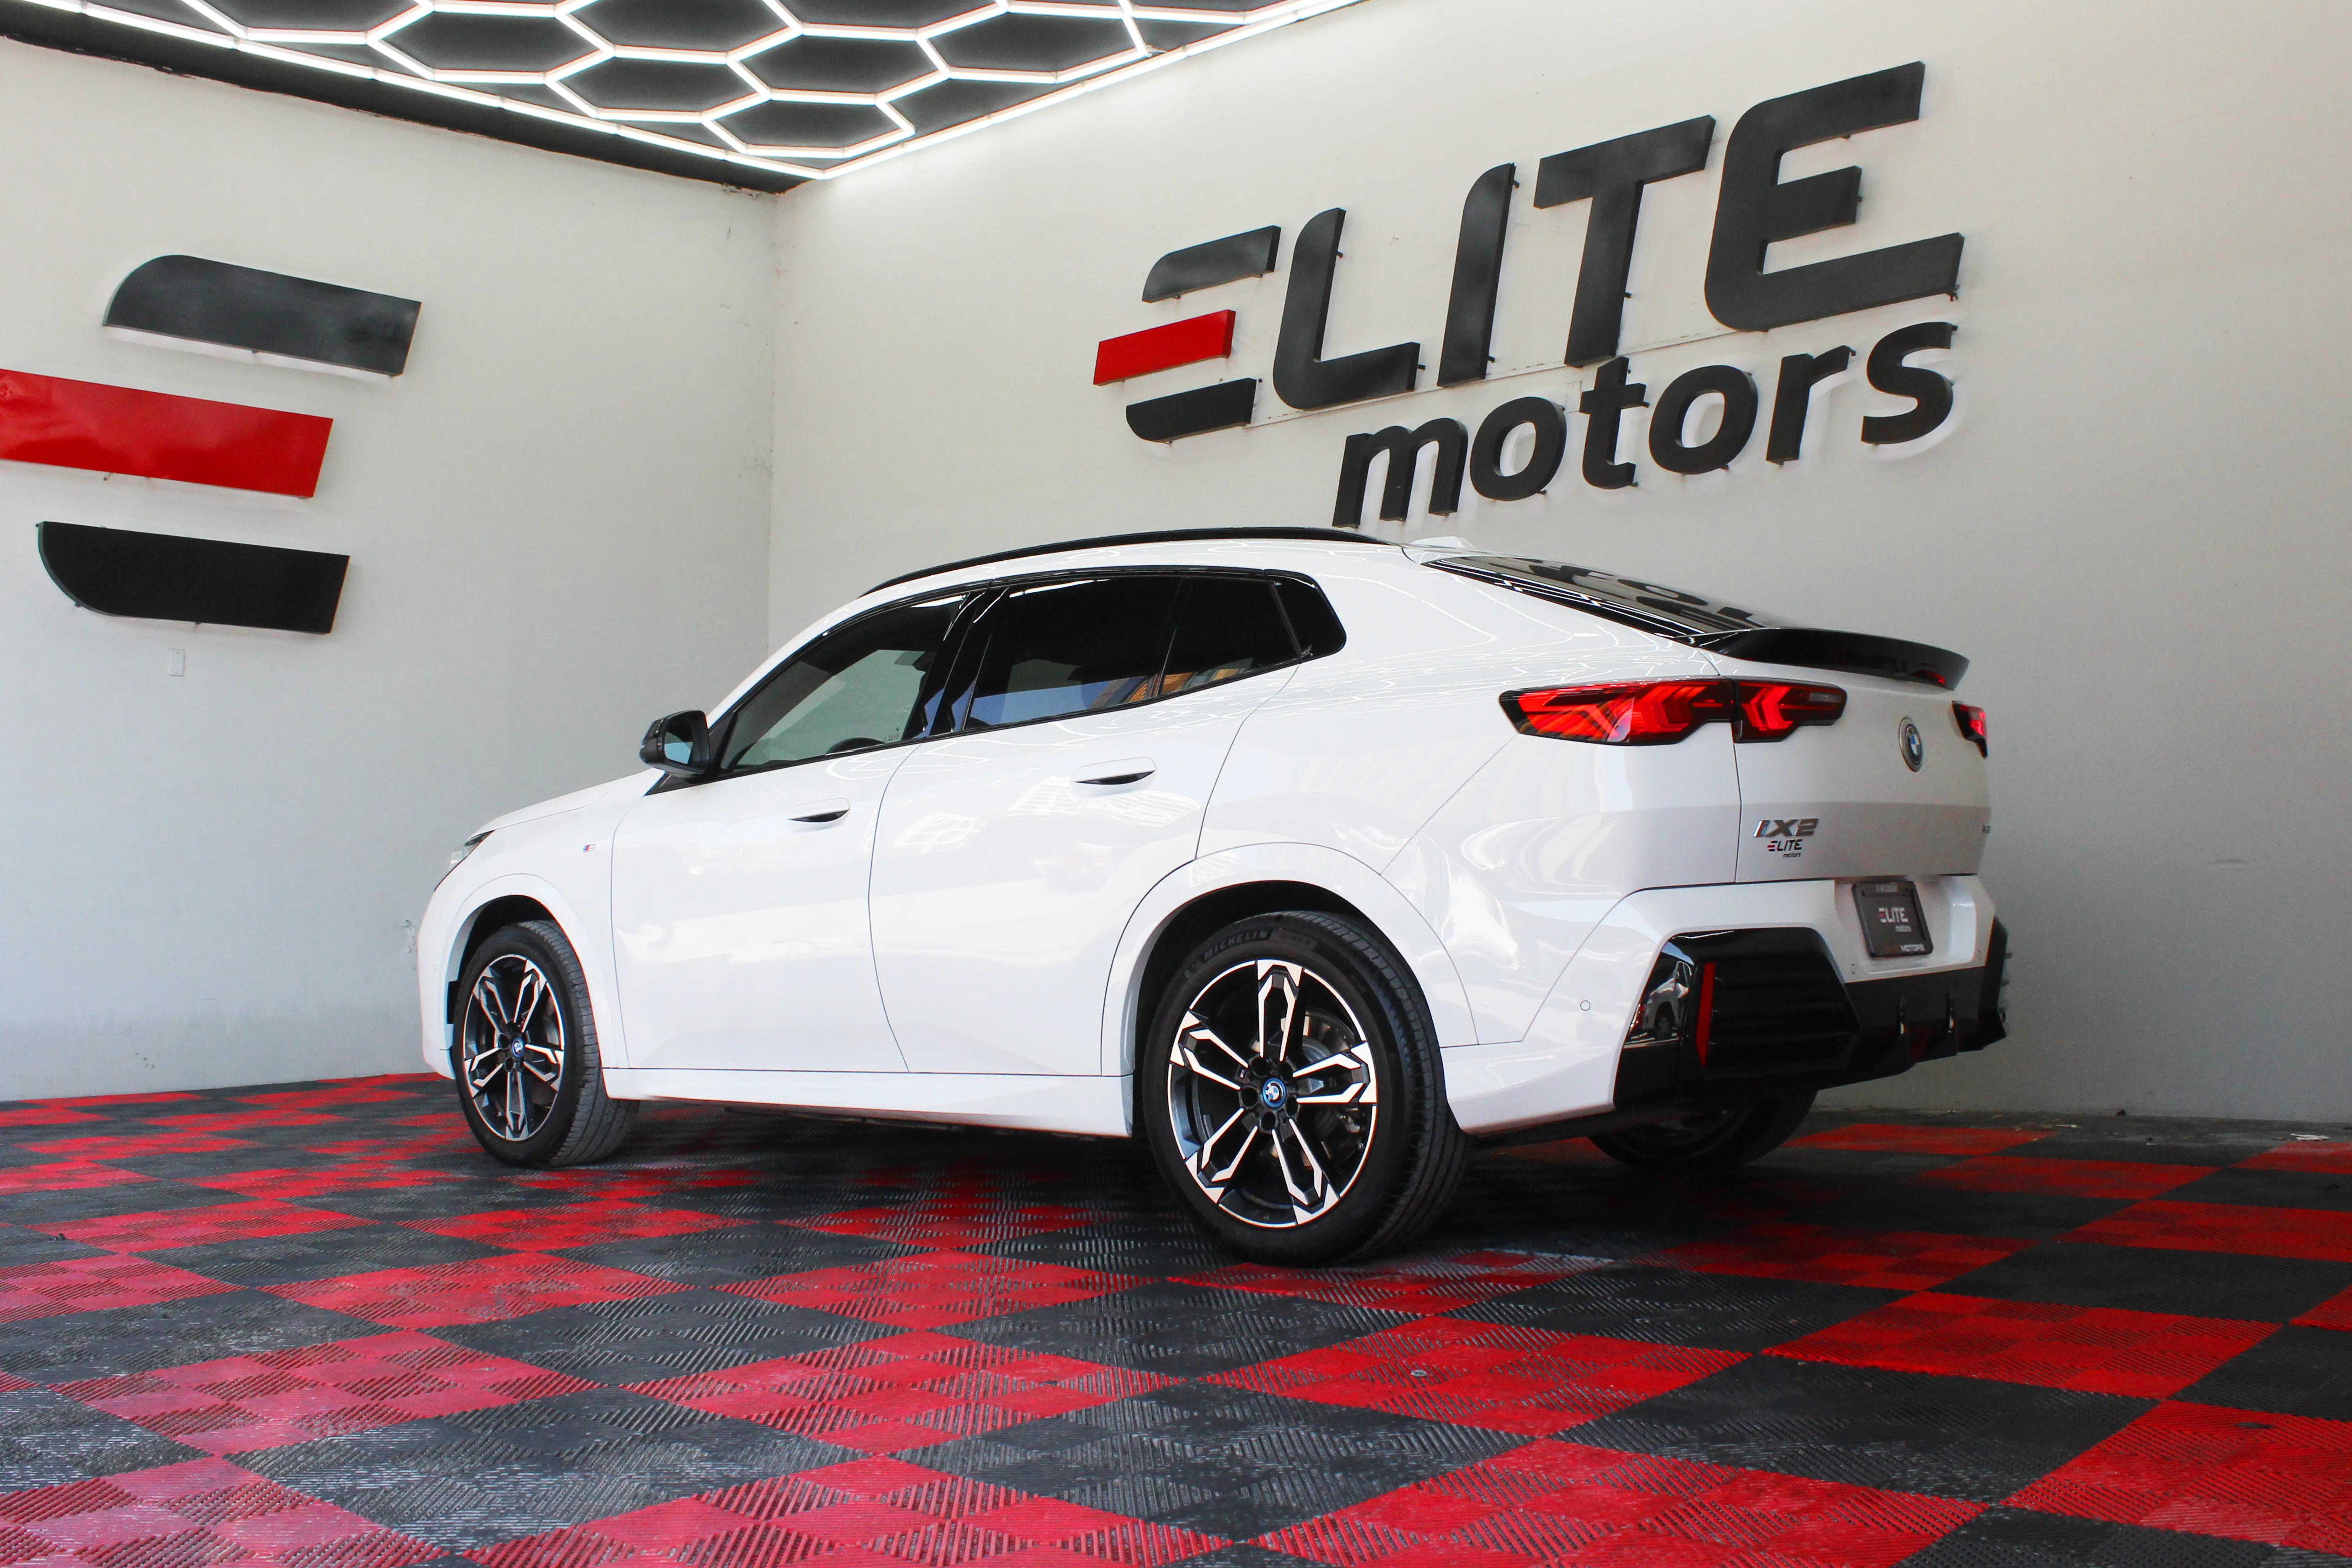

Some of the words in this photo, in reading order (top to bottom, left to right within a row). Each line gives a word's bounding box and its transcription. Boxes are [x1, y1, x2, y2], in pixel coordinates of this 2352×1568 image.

[1094, 61, 1964, 440] ELITE
[1333, 322, 1958, 527] motors
[1767, 839, 1803, 852] ELITE
[1878, 907, 1909, 923] ELITE
[1204, 930, 1268, 960] MICHELIN
